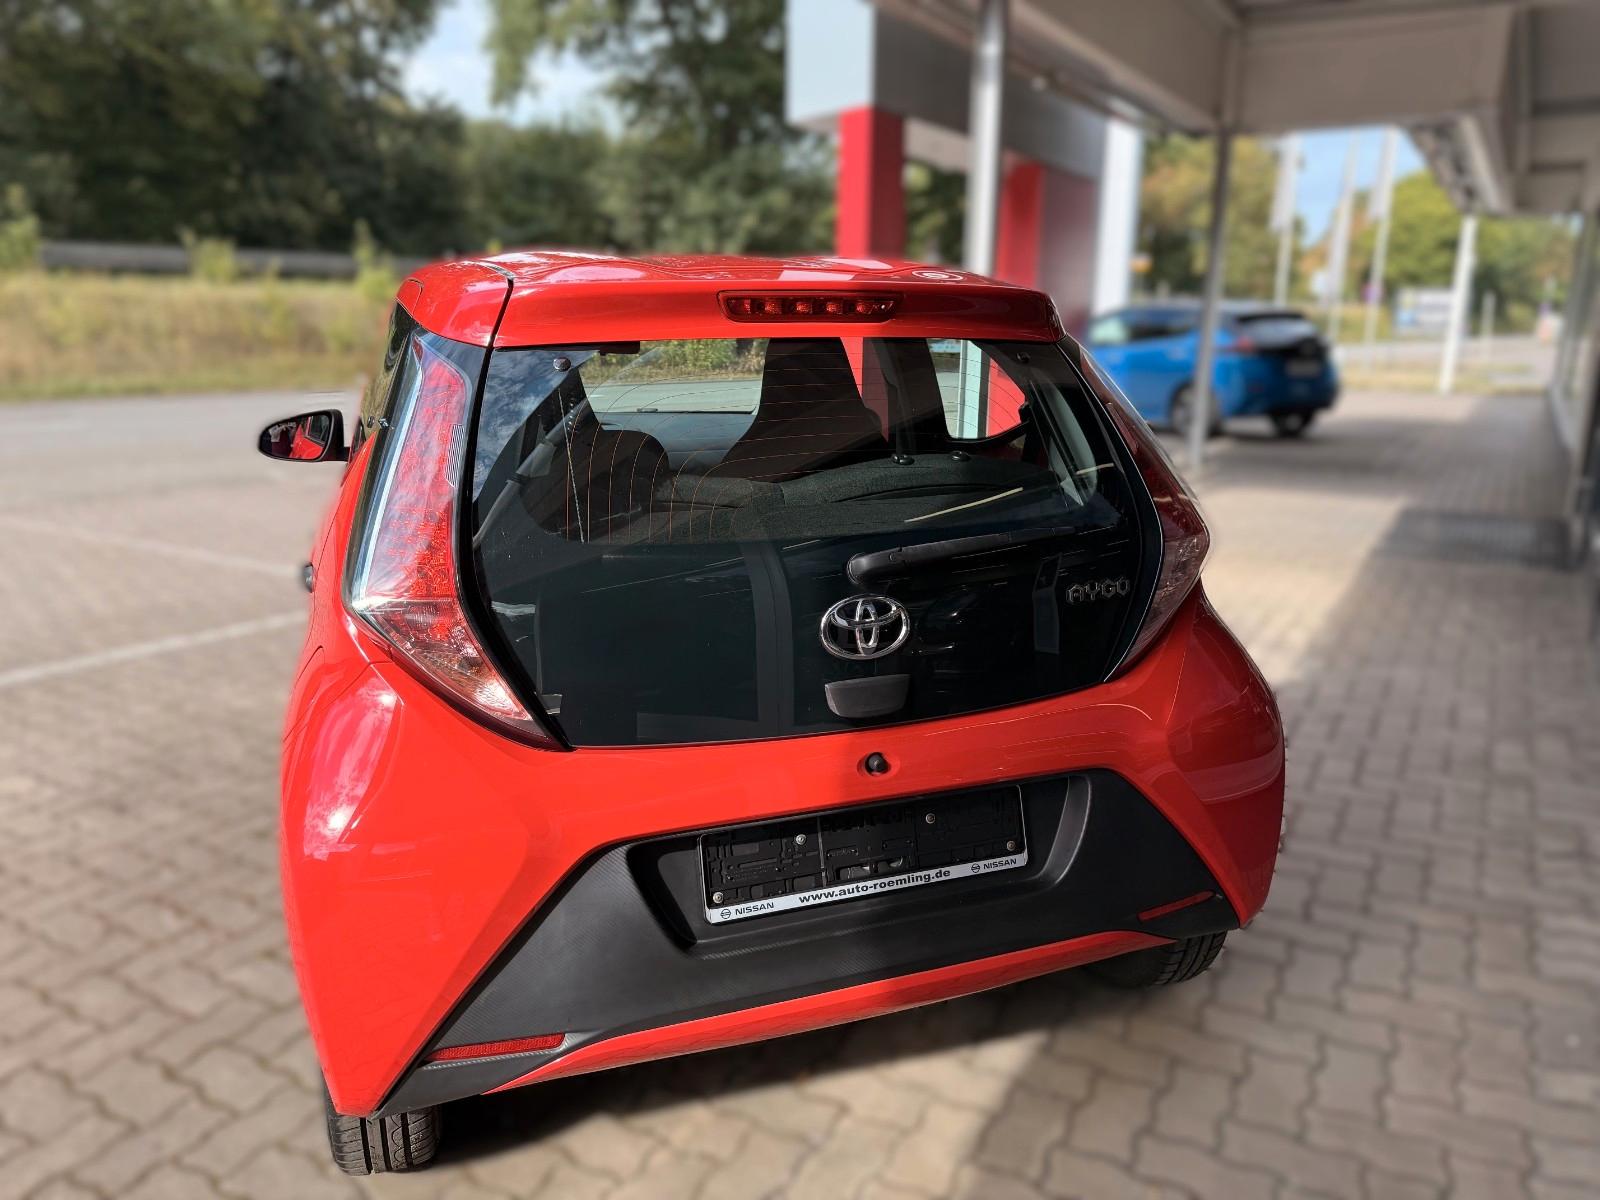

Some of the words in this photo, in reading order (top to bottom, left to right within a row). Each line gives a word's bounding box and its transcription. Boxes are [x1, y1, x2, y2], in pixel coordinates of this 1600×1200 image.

[1066, 577, 1130, 602] AYGO
[735, 902, 774, 916] NISSAN
[799, 869, 951, 903] www.auto-roemling.de
[983, 858, 1017, 869] NISSAN
